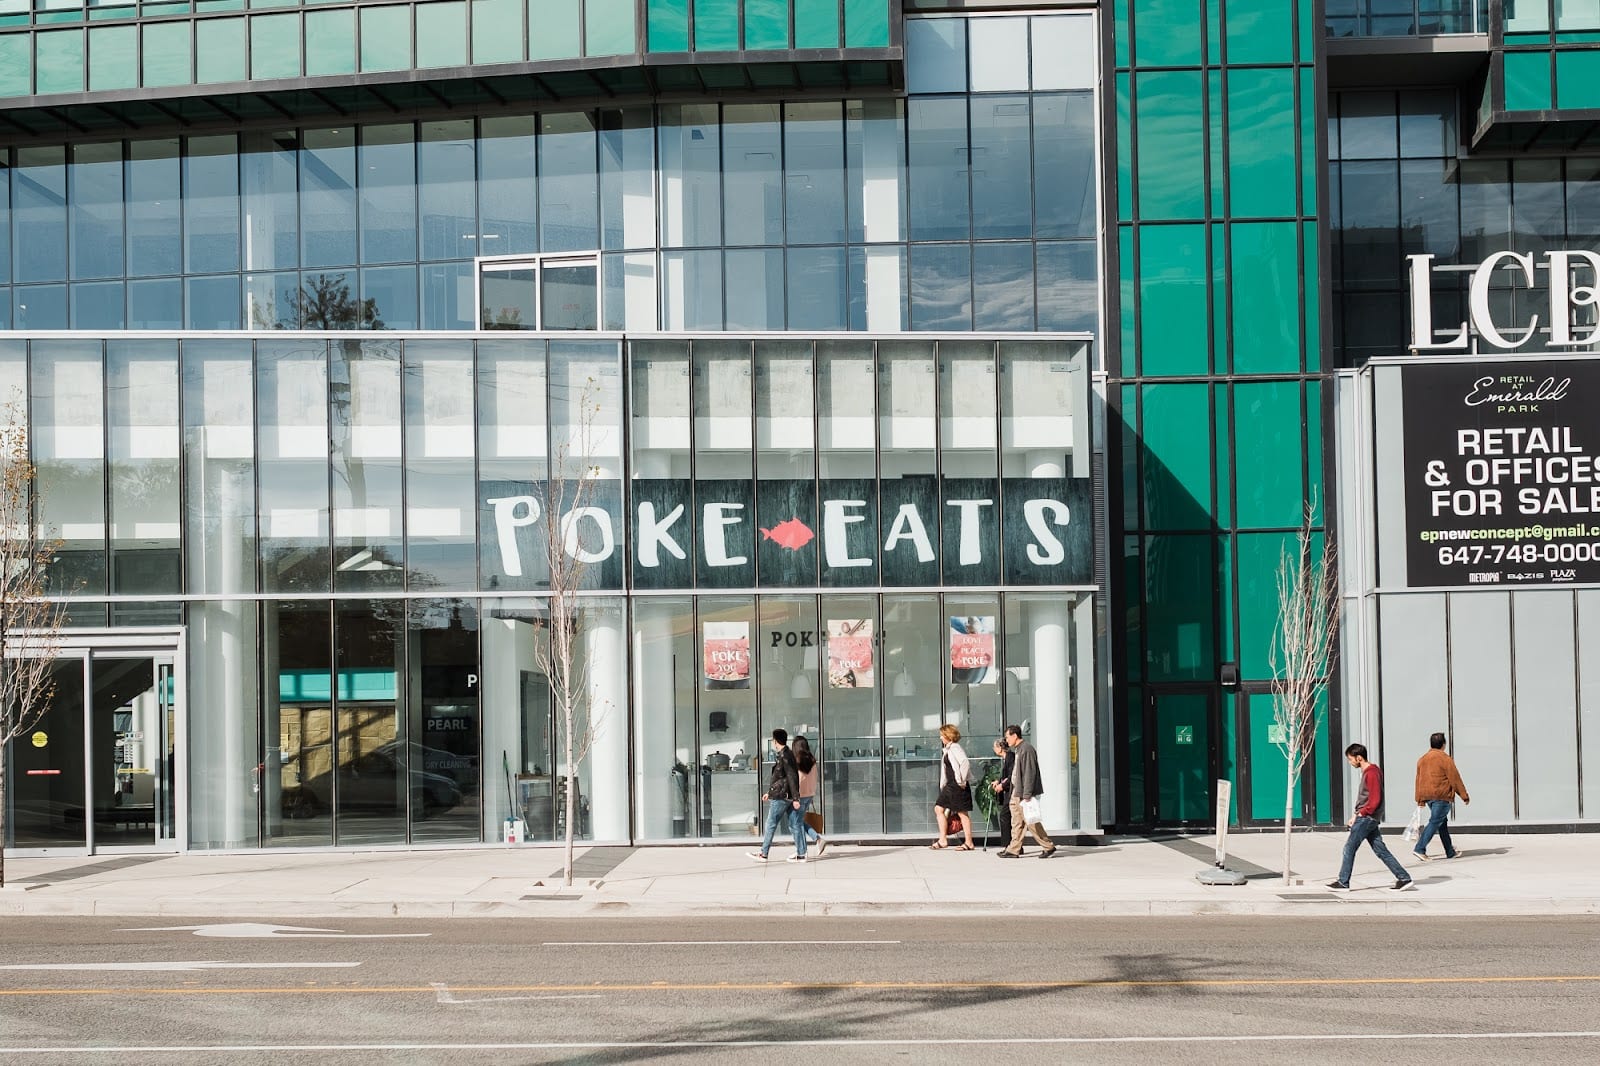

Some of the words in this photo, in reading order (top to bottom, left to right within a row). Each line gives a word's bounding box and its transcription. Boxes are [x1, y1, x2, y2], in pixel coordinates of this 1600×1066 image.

[1405, 250, 1600, 349] LCB
[1464, 376, 1571, 406] Emerald
[1497, 405, 1539, 413] PARK
[1457, 427, 1583, 455] RETAIL
[1424, 460, 1451, 487] &
[1431, 489, 1502, 516] FOR
[487, 496, 748, 577] POKE
[824, 499, 1070, 567] EATS
[1550, 569, 1576, 578] PLAZA
[711, 650, 744, 664] POKE
[962, 656, 985, 666] POKE
[427, 719, 468, 731] PEARL
